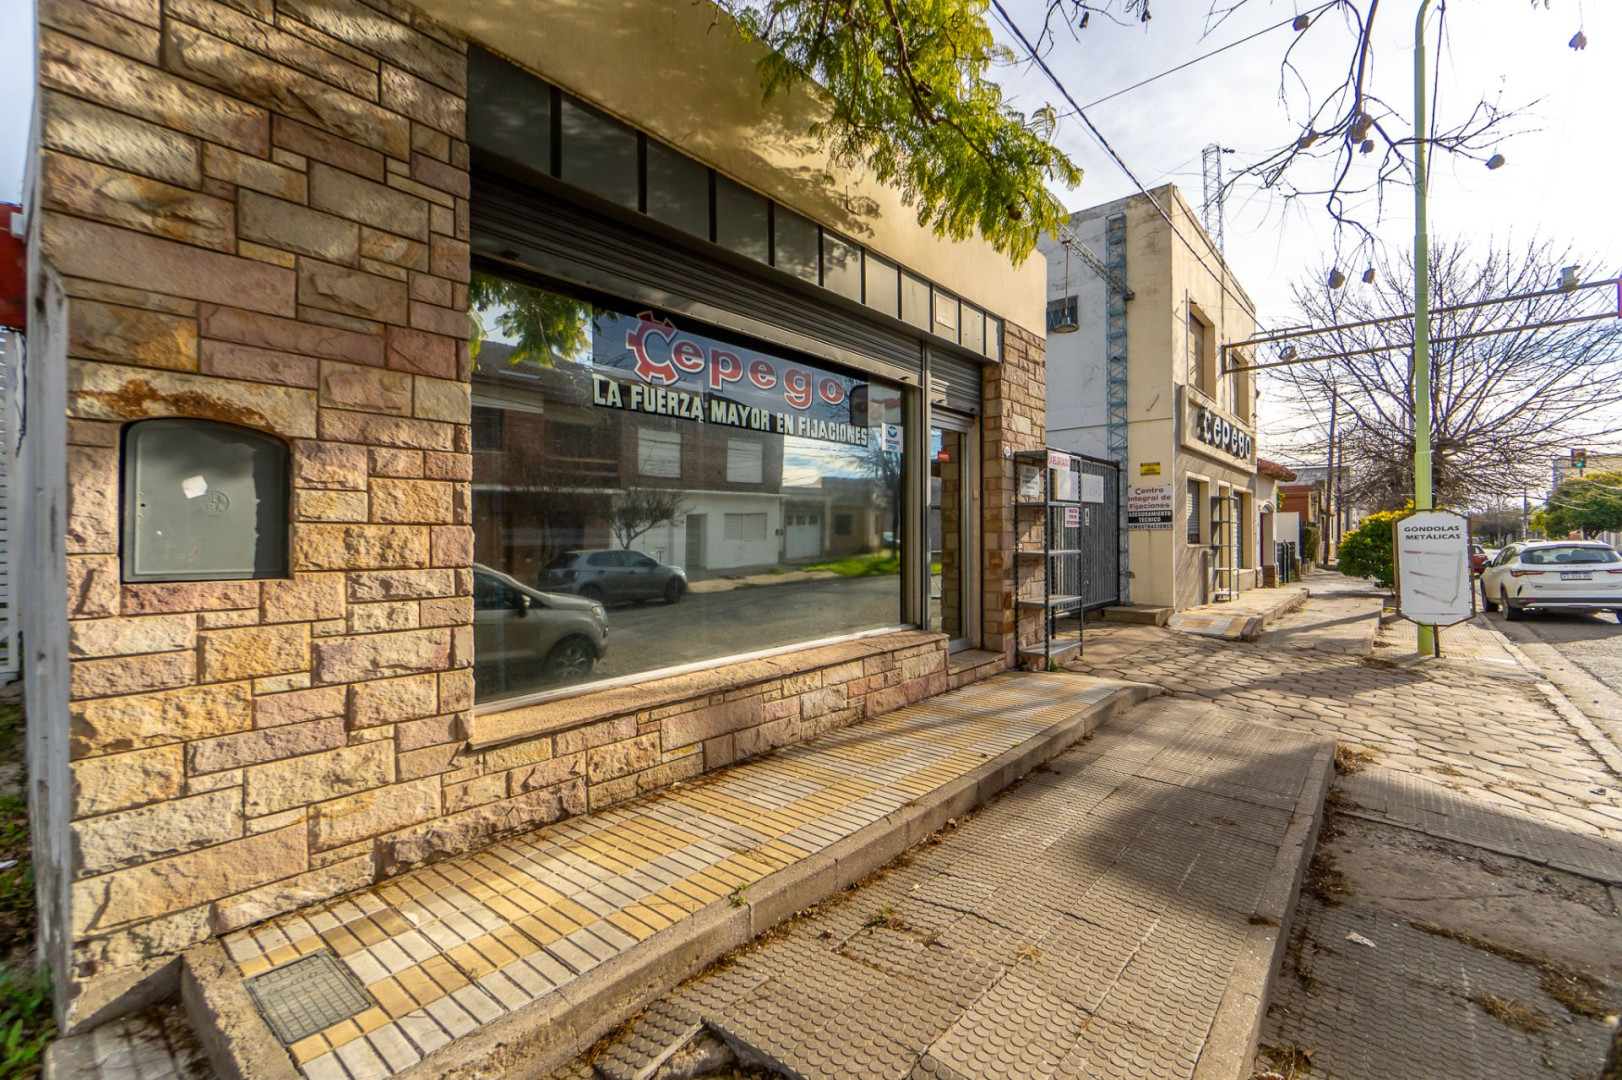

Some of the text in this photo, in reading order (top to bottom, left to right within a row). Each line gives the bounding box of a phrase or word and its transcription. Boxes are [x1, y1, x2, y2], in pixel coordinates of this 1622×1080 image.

[625, 311, 845, 410] Cepego
[592, 374, 869, 447] LA FUERZA MAYOR EN FIJACIONES
[1135, 487, 1164, 495] Centro
[1128, 495, 1159, 503] Integral
[1129, 502, 1170, 510] Fijaciones
